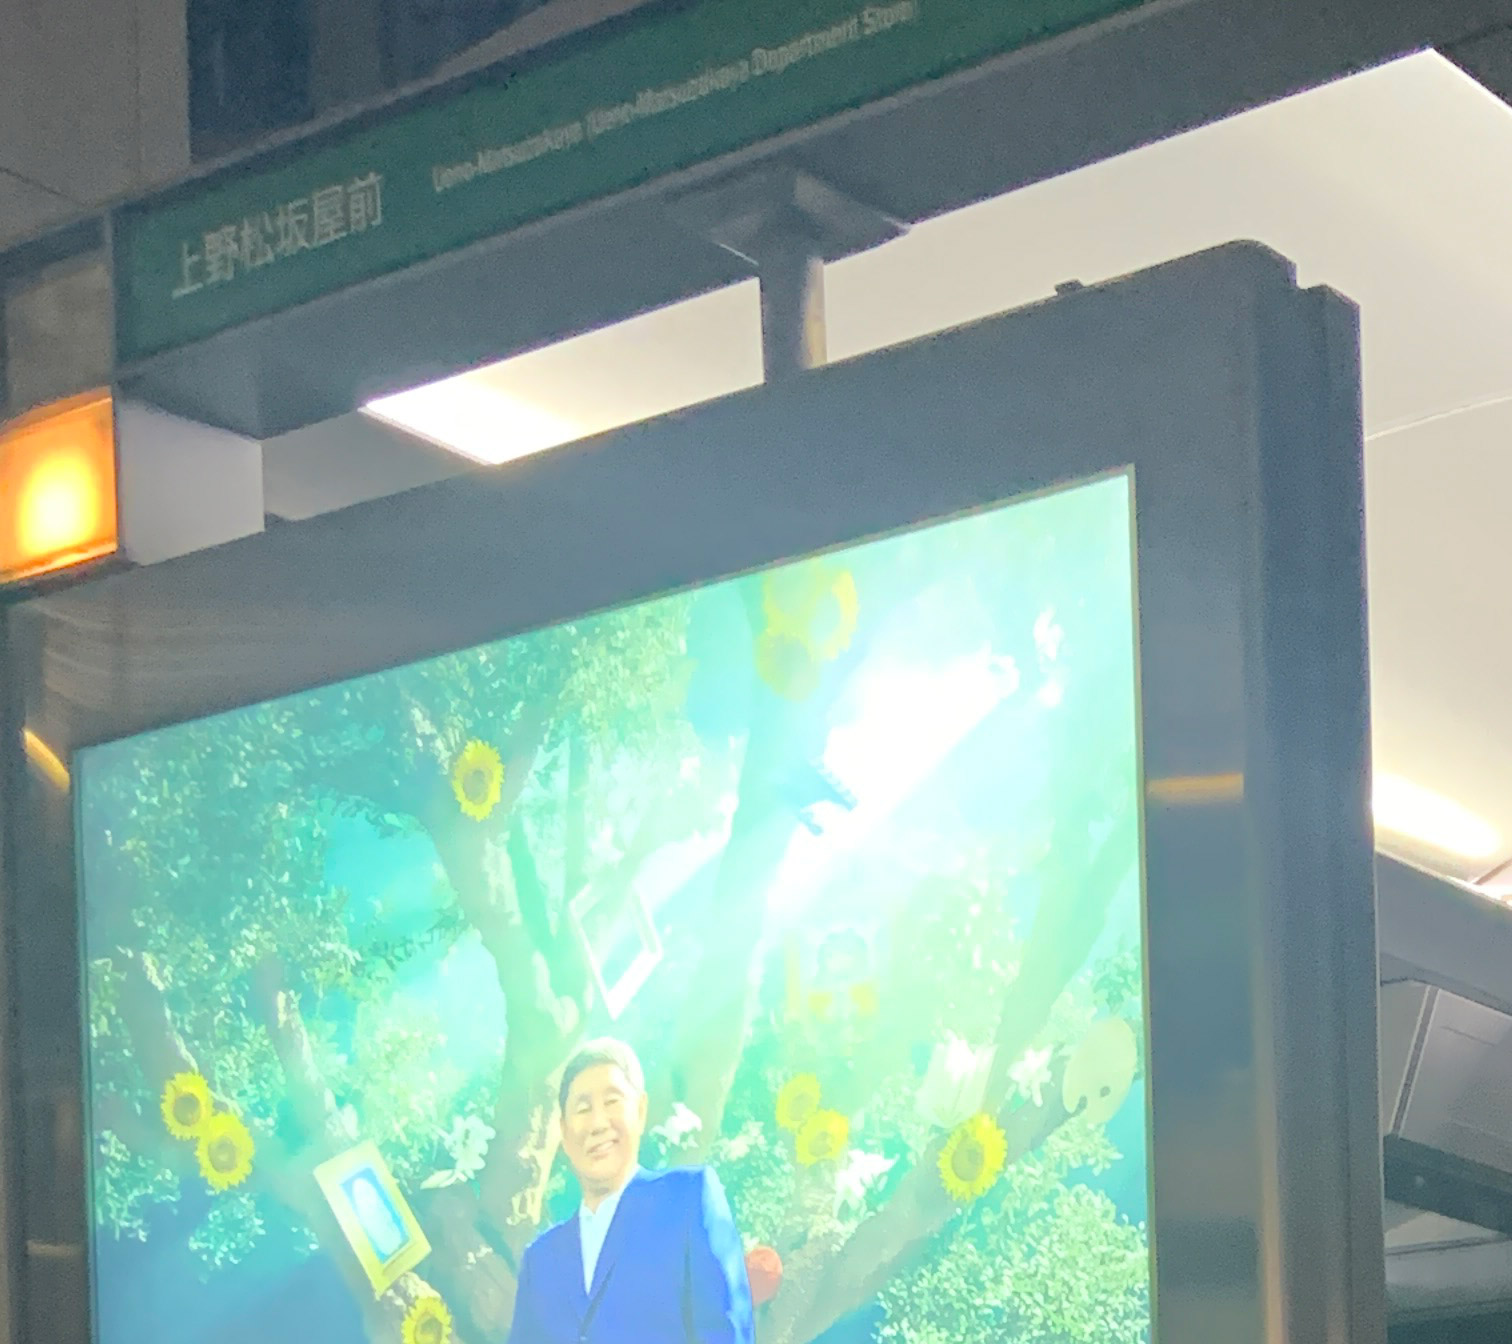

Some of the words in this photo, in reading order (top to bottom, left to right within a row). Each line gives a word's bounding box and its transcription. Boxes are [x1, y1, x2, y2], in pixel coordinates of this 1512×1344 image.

[172, 171, 382, 298] 上野松坂屋前
